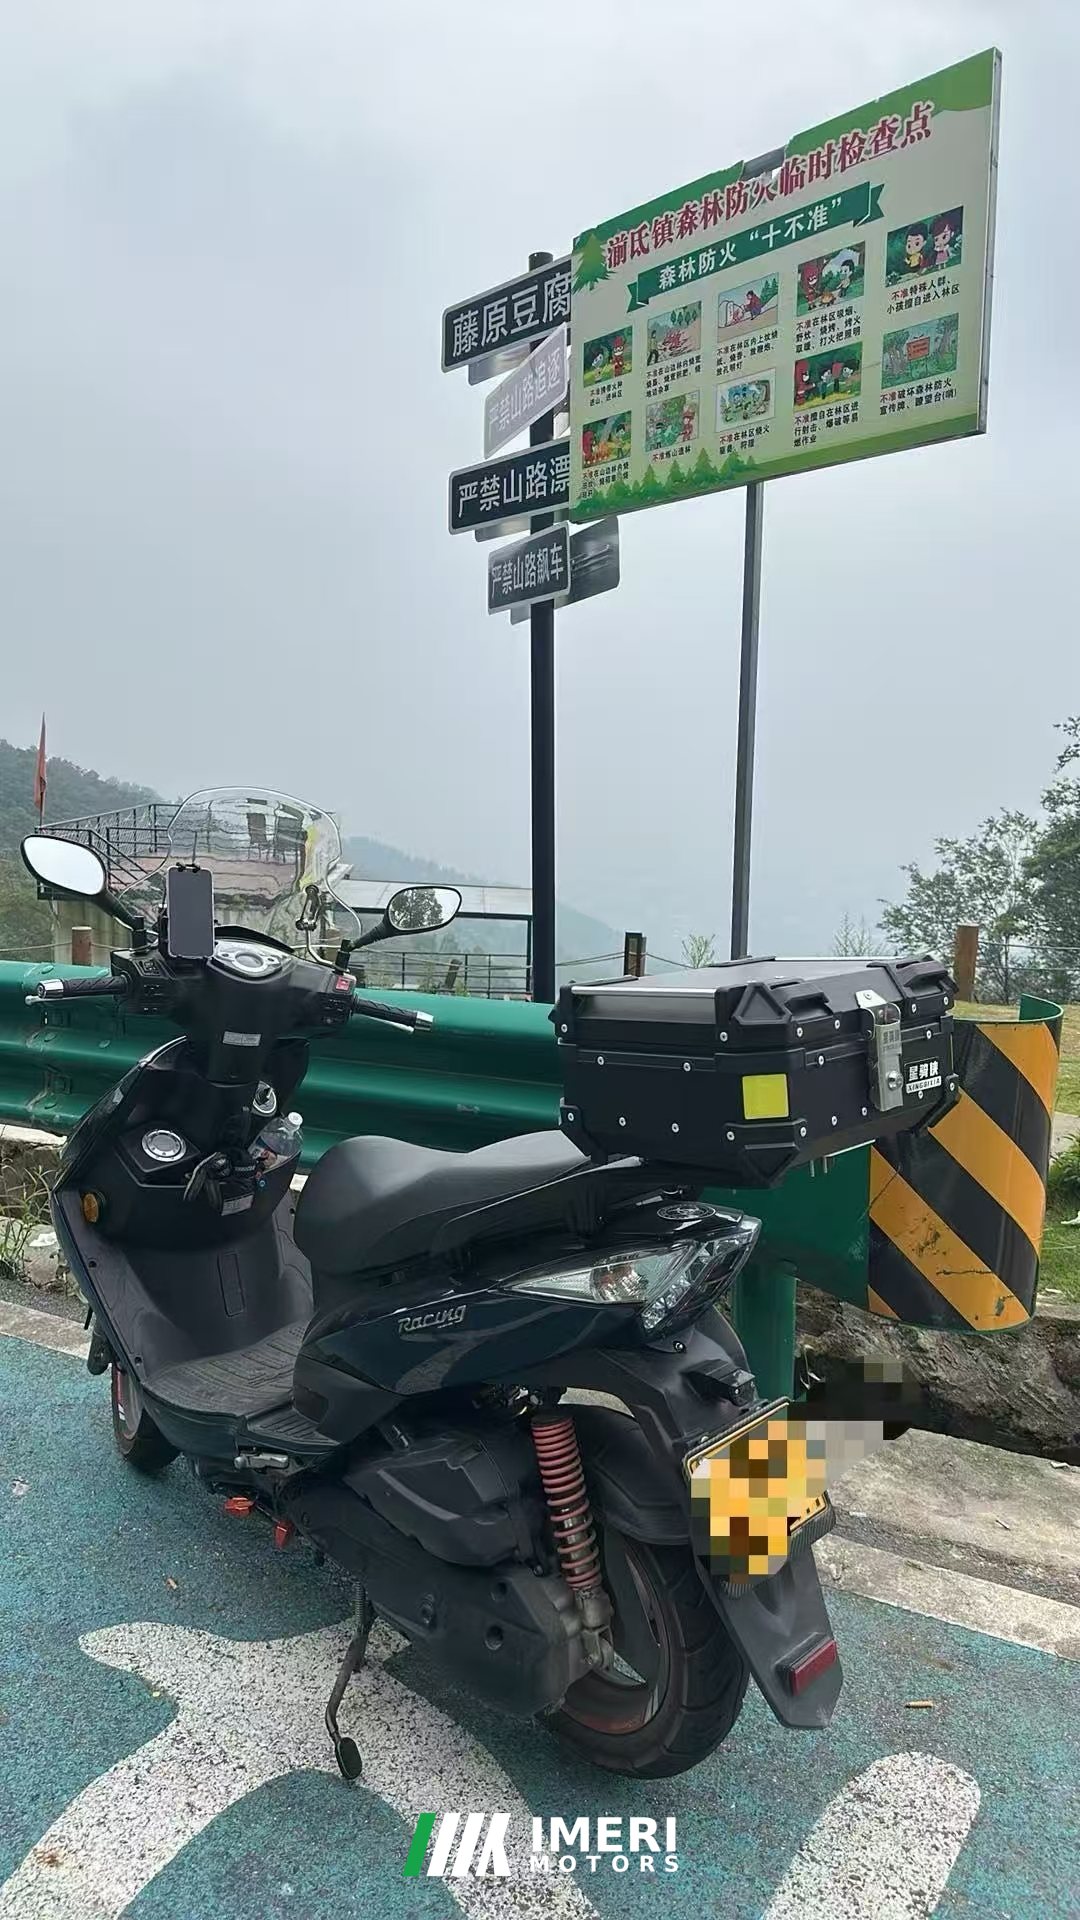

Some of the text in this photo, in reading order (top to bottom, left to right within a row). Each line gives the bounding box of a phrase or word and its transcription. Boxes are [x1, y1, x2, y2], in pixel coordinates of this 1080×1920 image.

[659, 243, 736, 290] 森林防火
[453, 272, 571, 357] 藤原豆腐
[887, 284, 960, 314] 小孩擅自进入林区
[488, 347, 561, 438] 严禁山路追逐
[458, 454, 569, 518] 严禁山路漂
[491, 542, 564, 599] 严禁山路飙车
